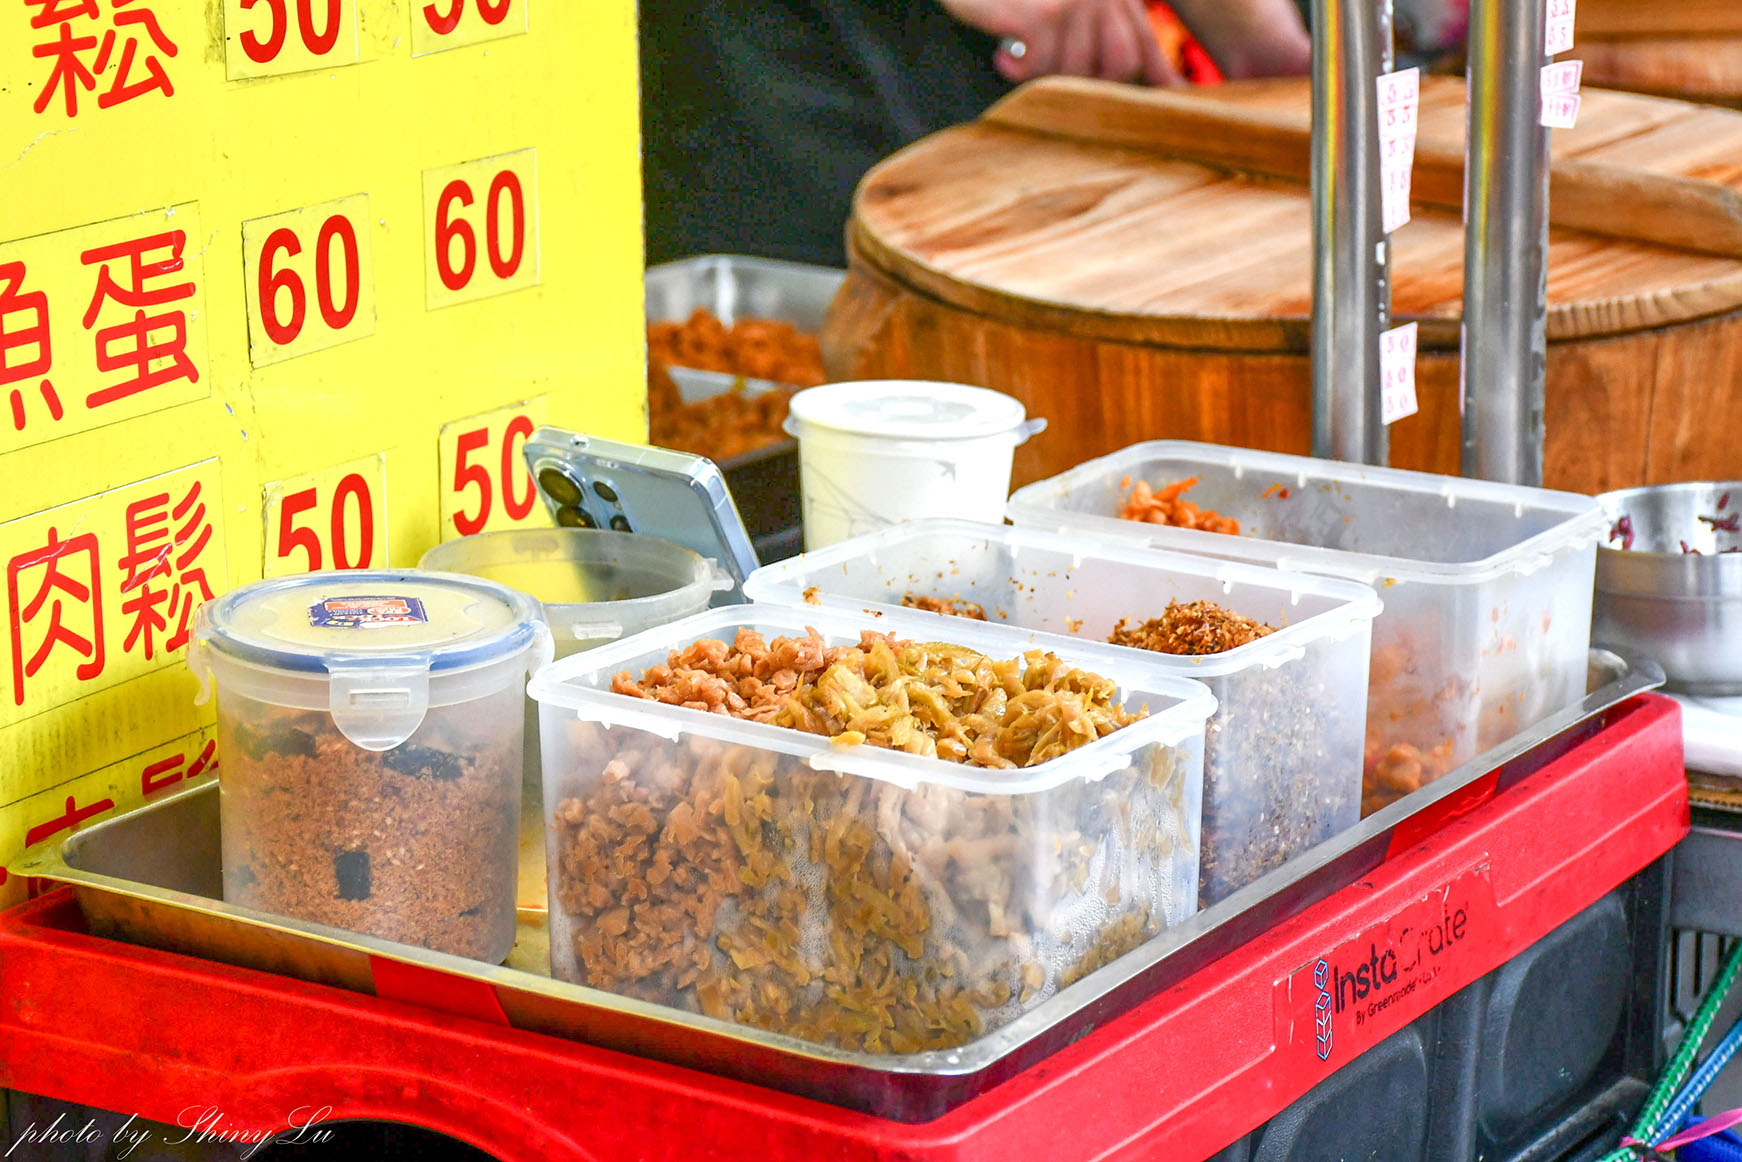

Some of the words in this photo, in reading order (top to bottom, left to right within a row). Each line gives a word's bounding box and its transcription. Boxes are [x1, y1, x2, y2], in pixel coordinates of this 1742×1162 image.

[258, 214, 360, 345] 60
[435, 170, 525, 291] 60
[278, 473, 374, 571] 50
[453, 415, 537, 537] 50
[8, 481, 215, 706] 肉鬆
